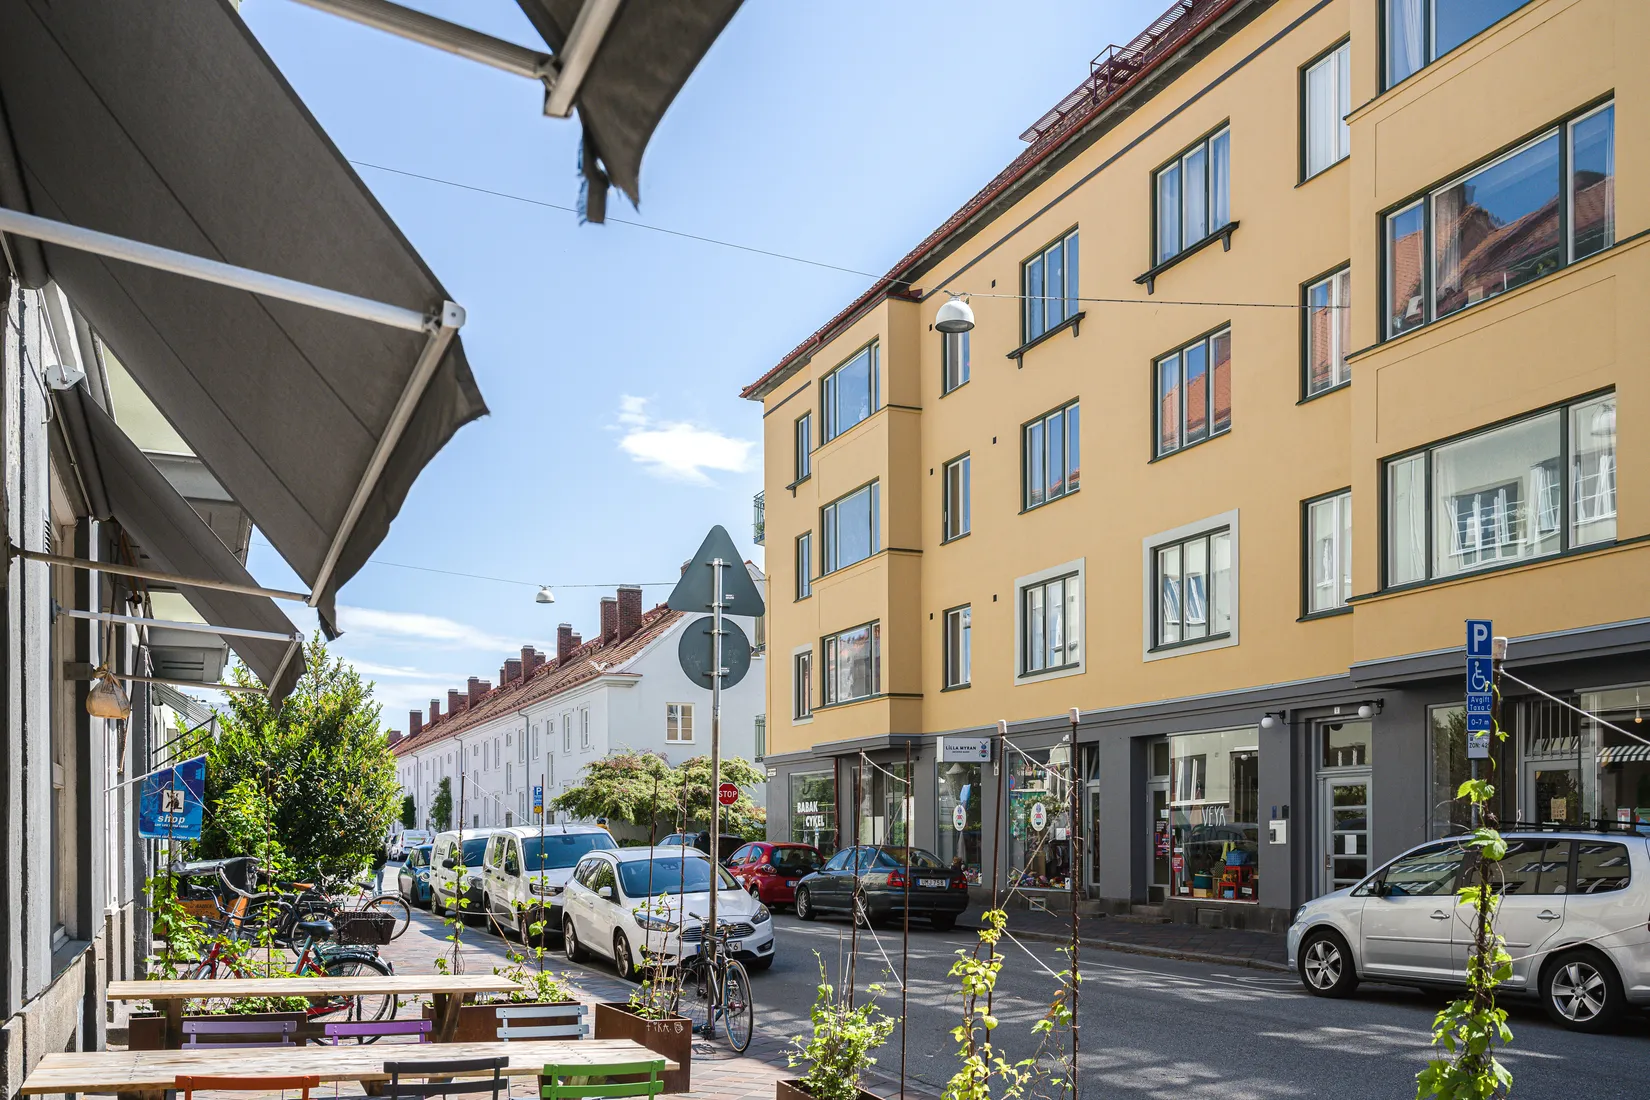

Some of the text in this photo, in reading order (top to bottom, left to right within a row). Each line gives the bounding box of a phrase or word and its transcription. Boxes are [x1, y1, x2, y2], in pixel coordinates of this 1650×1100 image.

[1473, 623, 1488, 653] P
[1470, 696, 1490, 705] Avgift
[536, 787, 542, 795] P
[719, 790, 738, 798] STOP
[797, 801, 819, 813] BABAK
[157, 814, 186, 825] shop
[805, 815, 825, 827] CYKEL
[1201, 805, 1226, 827] VEYA
